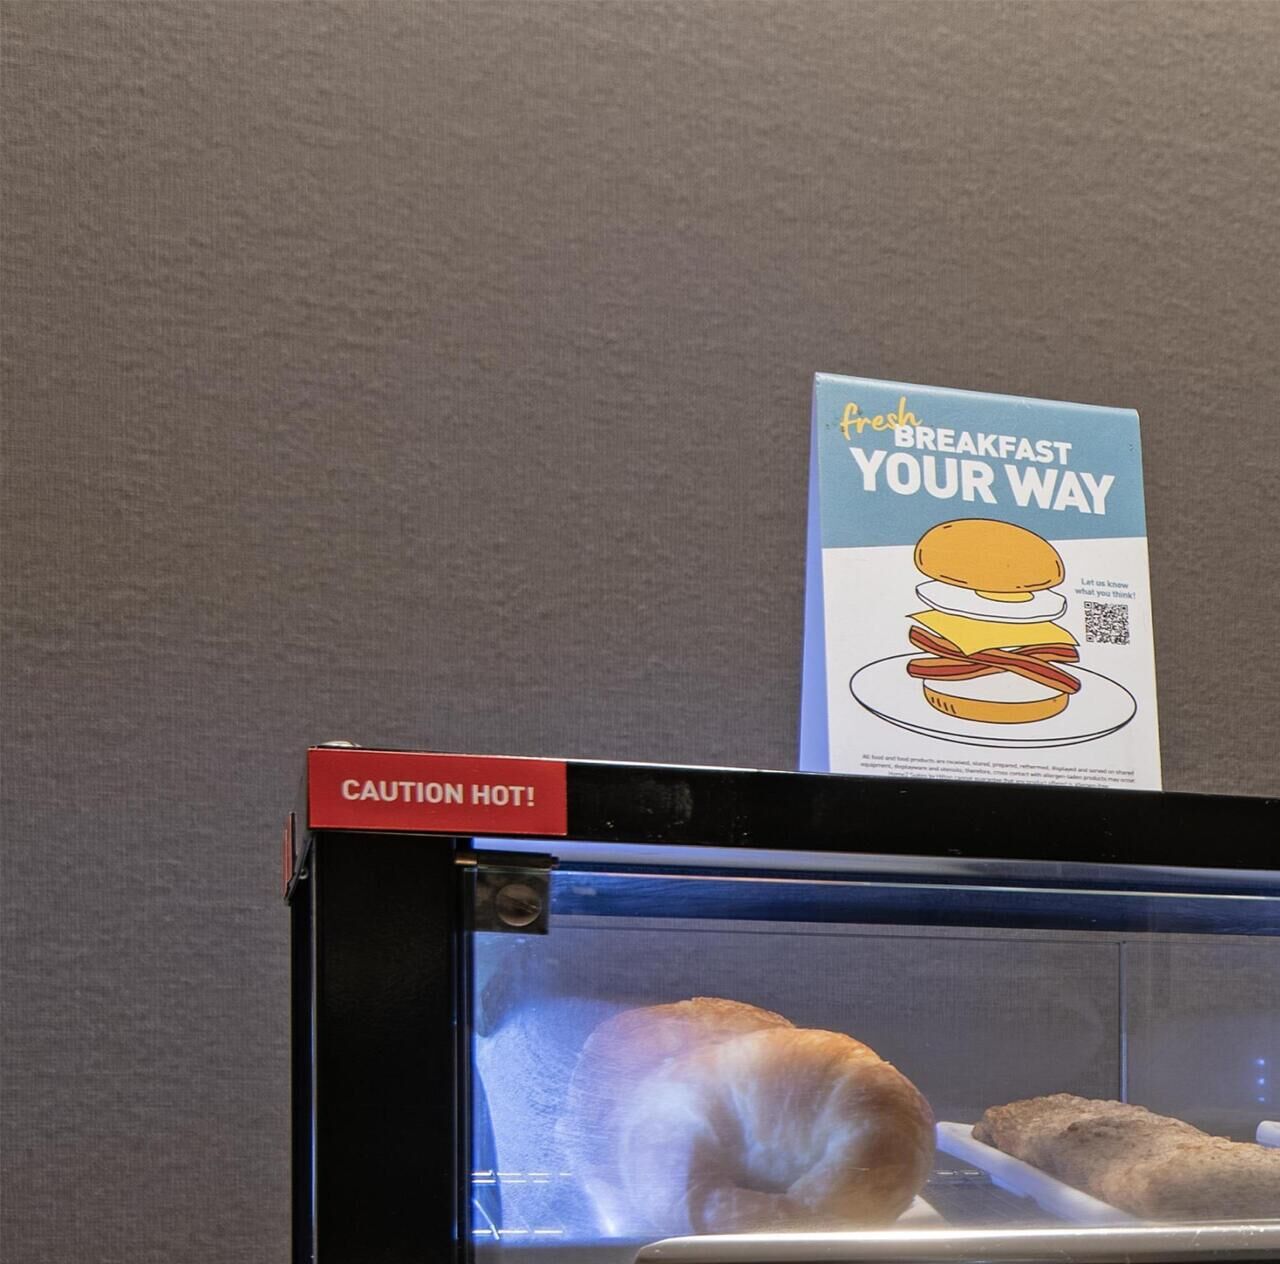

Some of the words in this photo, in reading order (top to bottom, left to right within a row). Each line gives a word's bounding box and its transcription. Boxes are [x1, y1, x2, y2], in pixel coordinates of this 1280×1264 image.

[840, 396, 922, 440] fresh
[894, 424, 1072, 465] BREAKFAST
[849, 447, 998, 505] YOUR
[1004, 464, 1116, 516] WAY
[1075, 588, 1095, 596] what
[1112, 591, 1136, 600] think!
[1081, 578, 1094, 586] Let
[1107, 580, 1129, 589] know
[342, 779, 463, 805] CAUTION
[472, 784, 535, 807] HOT!
